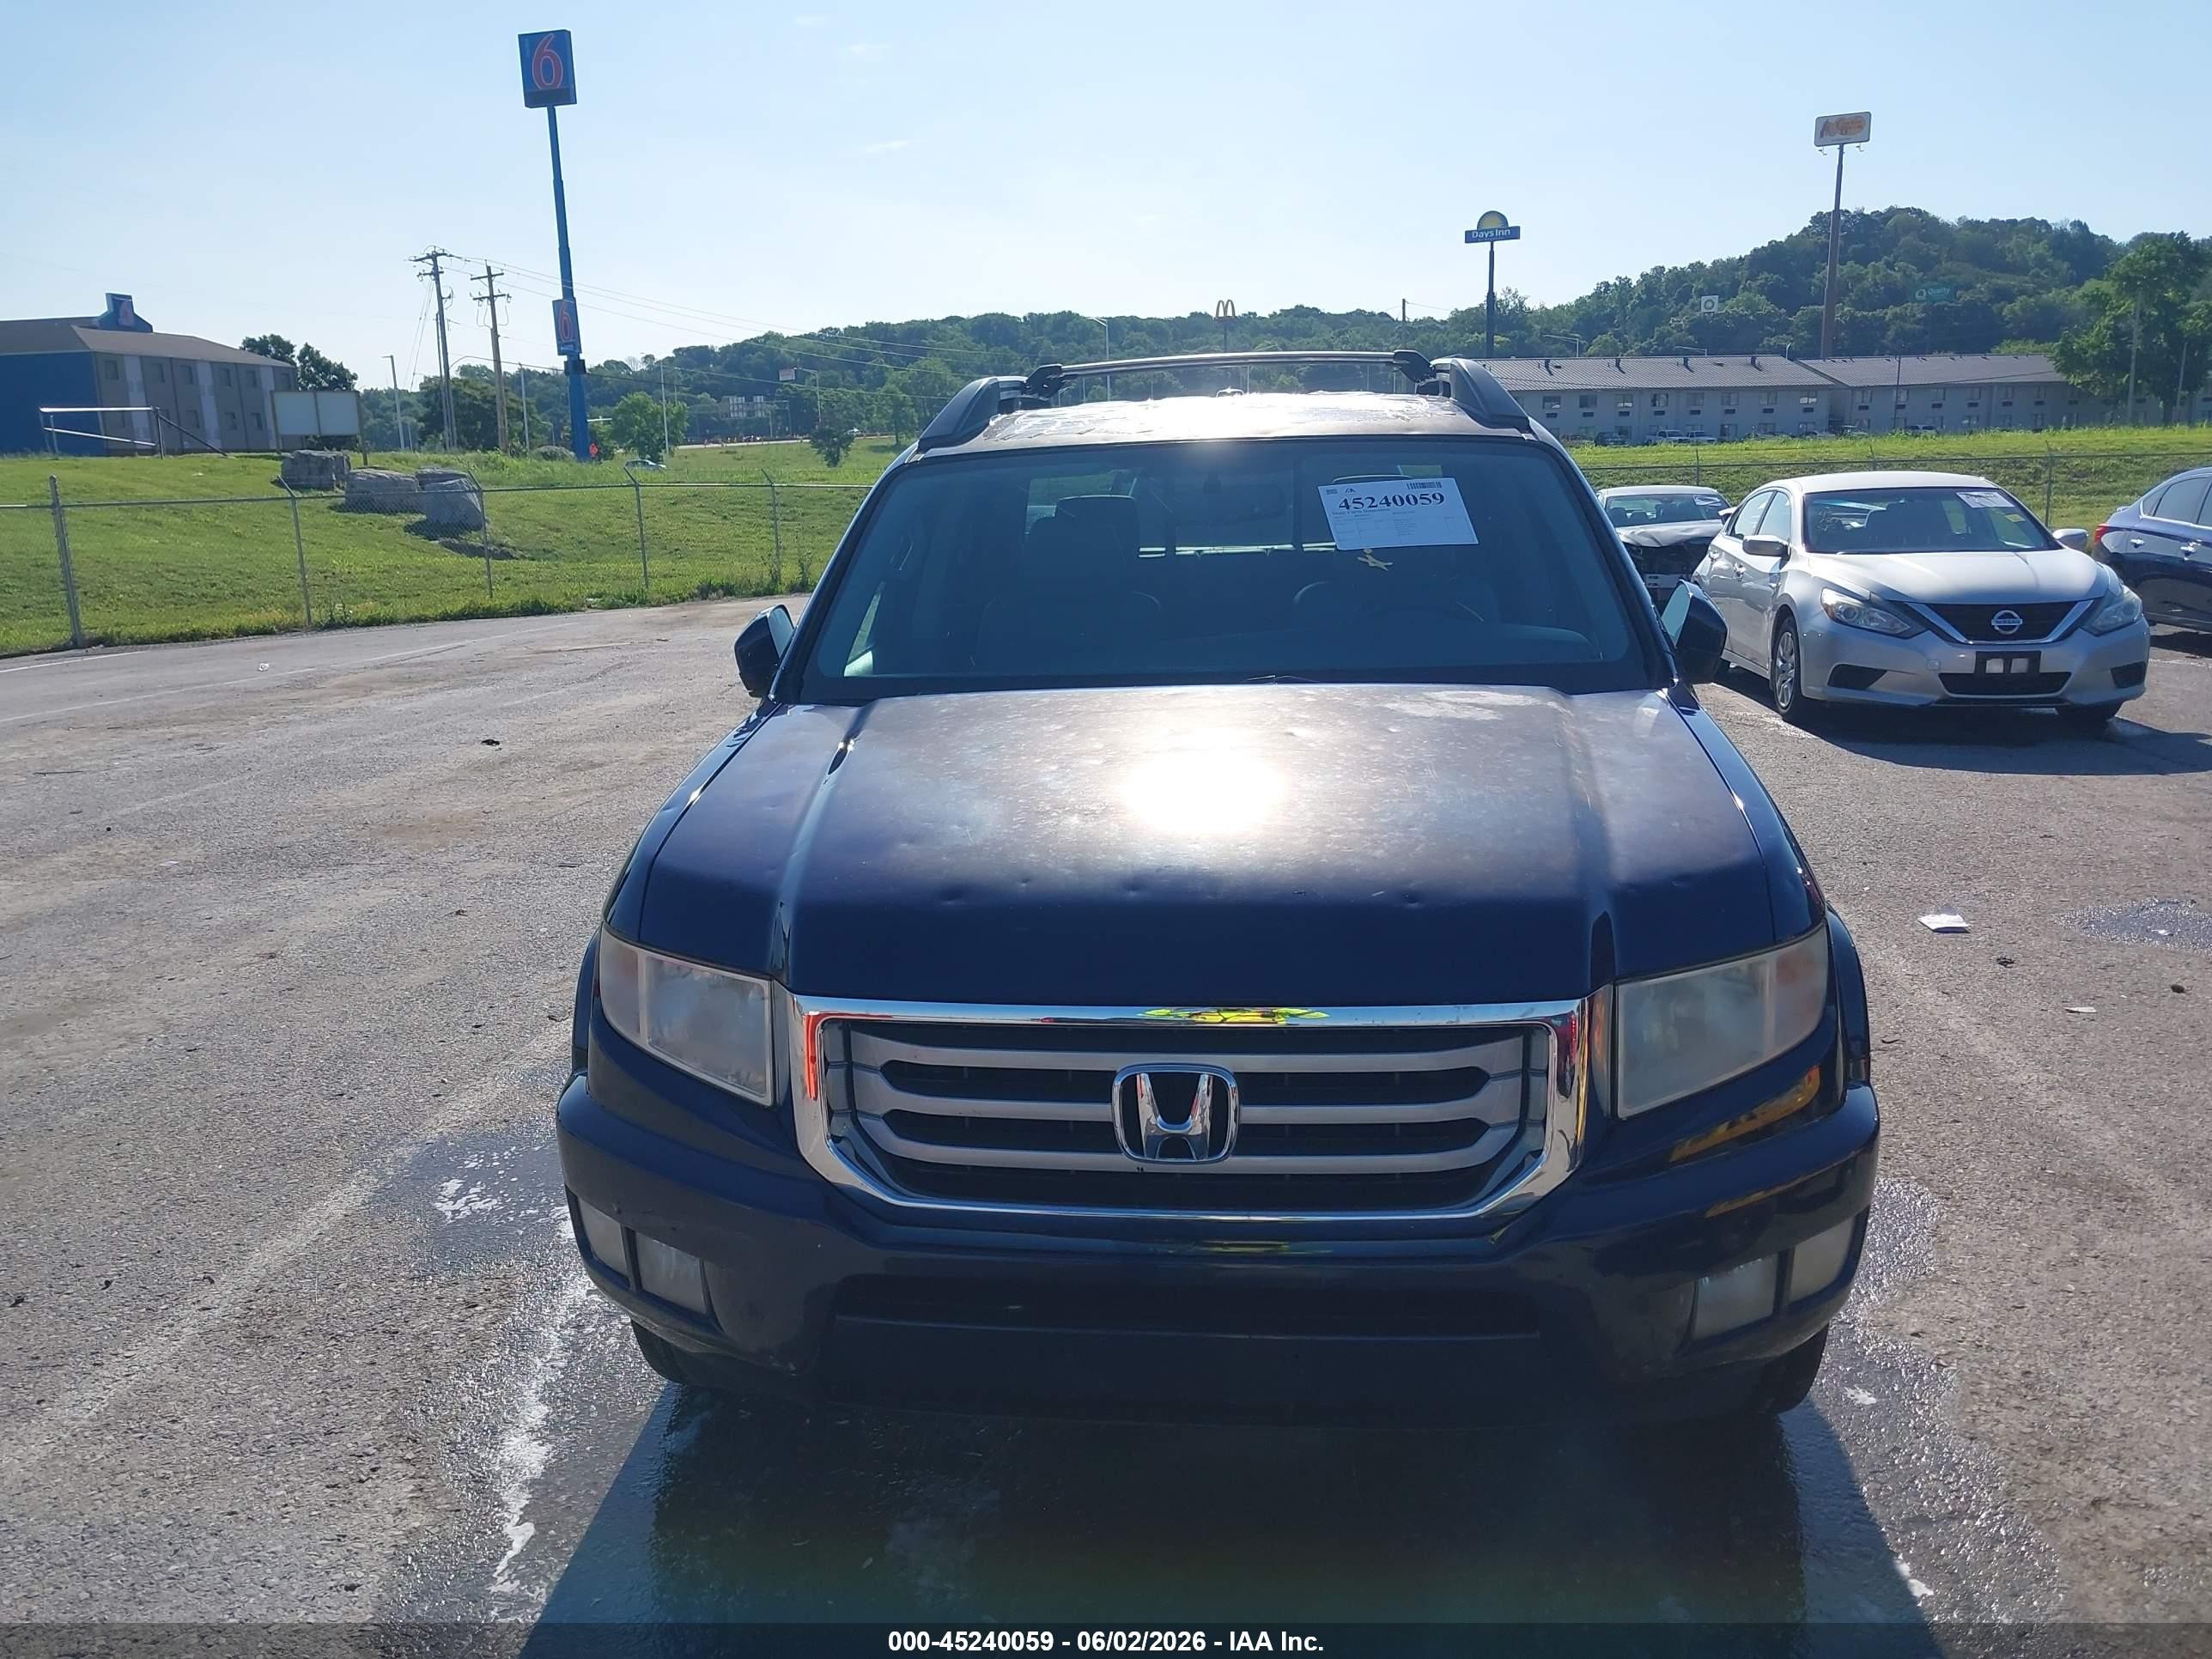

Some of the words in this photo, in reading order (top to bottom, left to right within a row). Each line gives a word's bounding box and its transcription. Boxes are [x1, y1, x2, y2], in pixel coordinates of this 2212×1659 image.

[532, 33, 563, 89] 6
[1472, 230, 1494, 239] Days
[1339, 492, 1444, 510] 45240059
